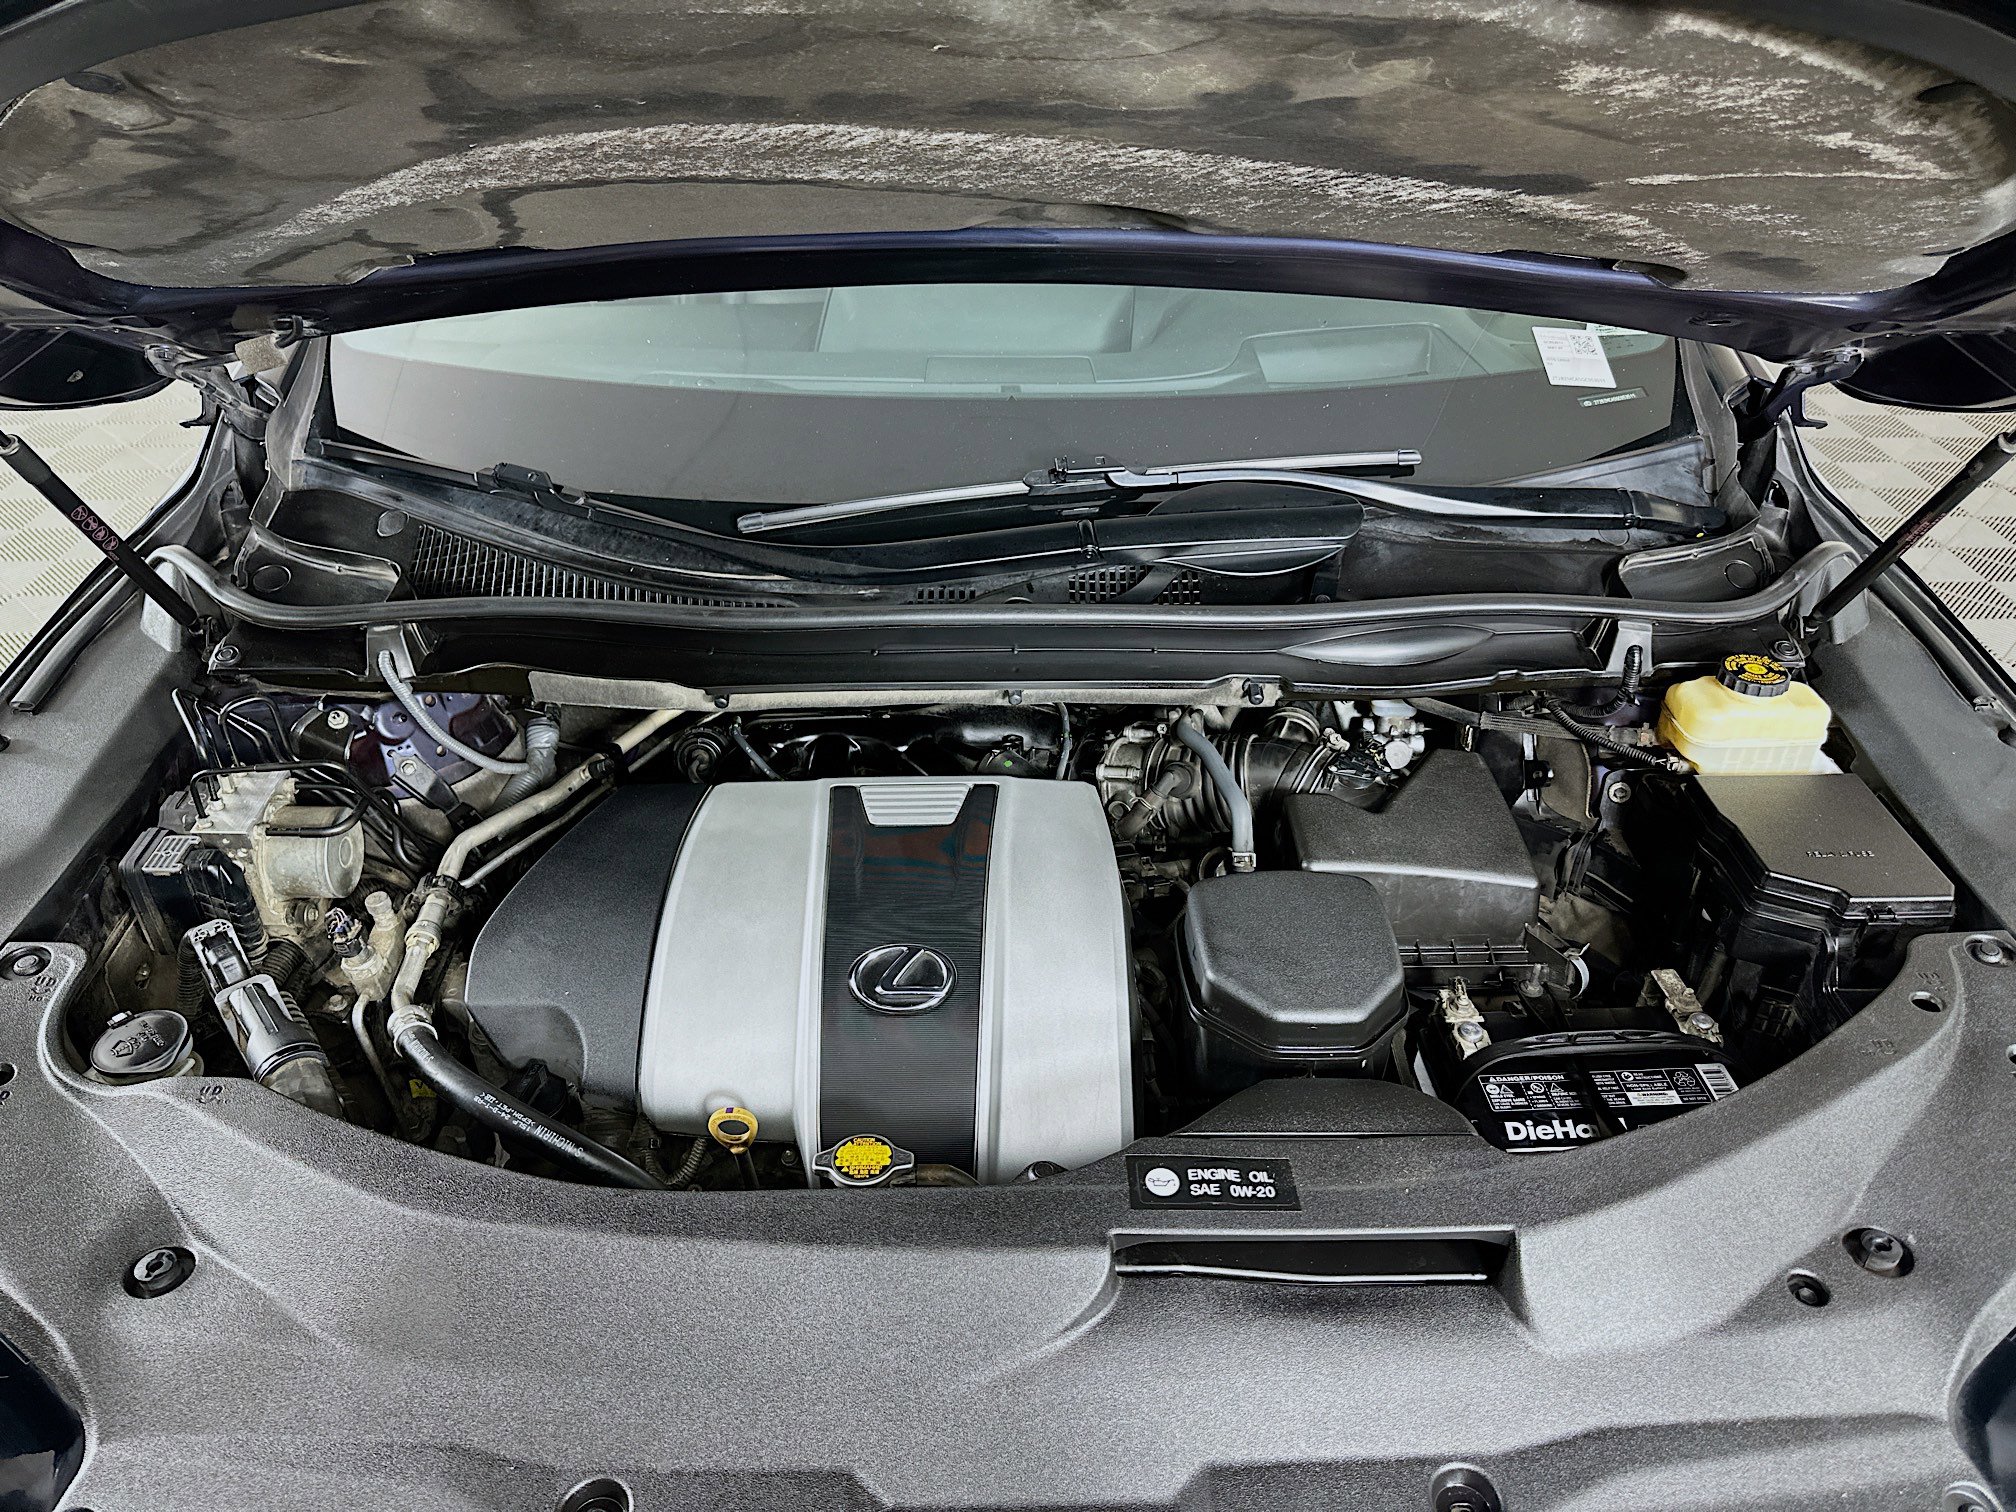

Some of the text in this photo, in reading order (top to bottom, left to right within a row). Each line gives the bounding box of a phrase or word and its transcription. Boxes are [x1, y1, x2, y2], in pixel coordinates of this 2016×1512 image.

[1187, 1168, 1274, 1183] ENGINE OIL
[1190, 1183, 1276, 1198] SAE 0W-20
